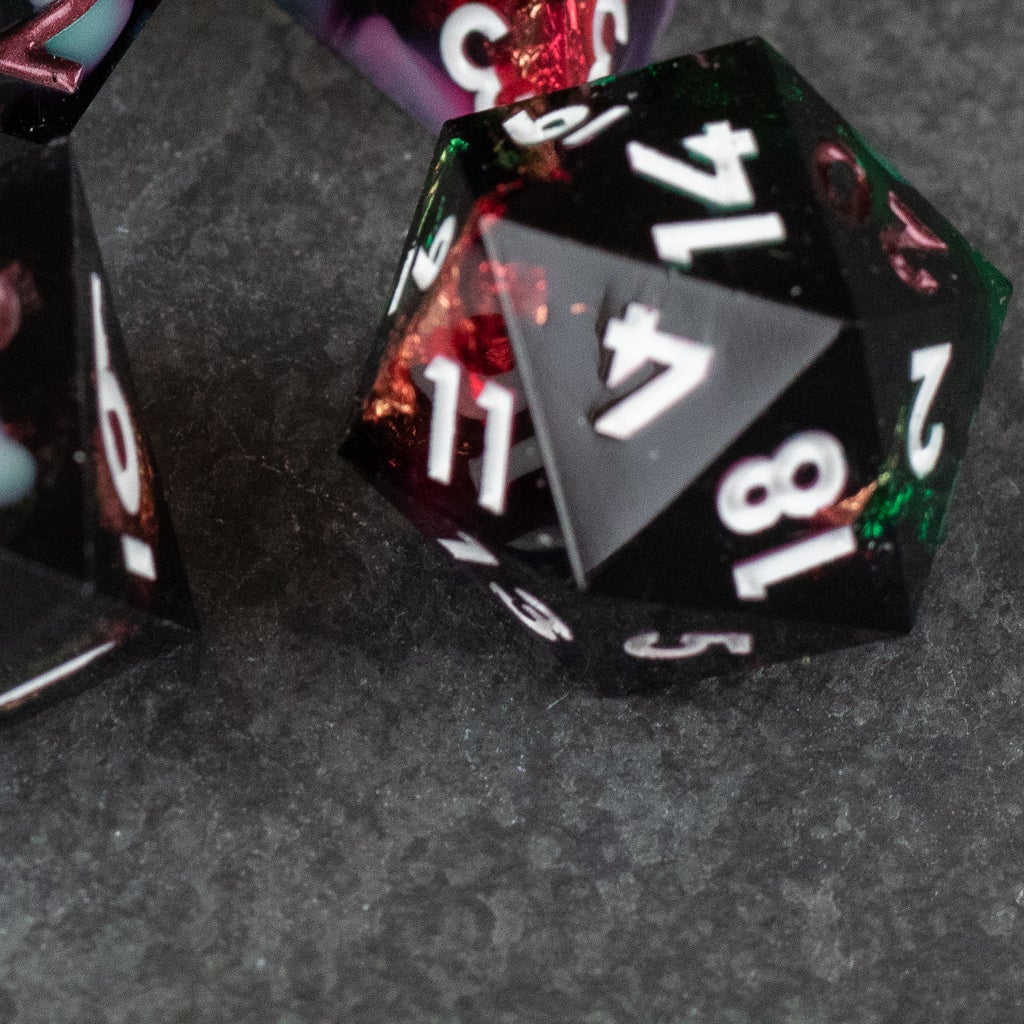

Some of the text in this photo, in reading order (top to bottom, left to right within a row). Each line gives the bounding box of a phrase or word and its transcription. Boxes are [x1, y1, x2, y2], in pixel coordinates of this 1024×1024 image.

[626, 119, 789, 271] 14
[423, 356, 516, 517] 11
[592, 301, 716, 443] 4
[906, 341, 954, 480] 2
[716, 429, 858, 602] 18
